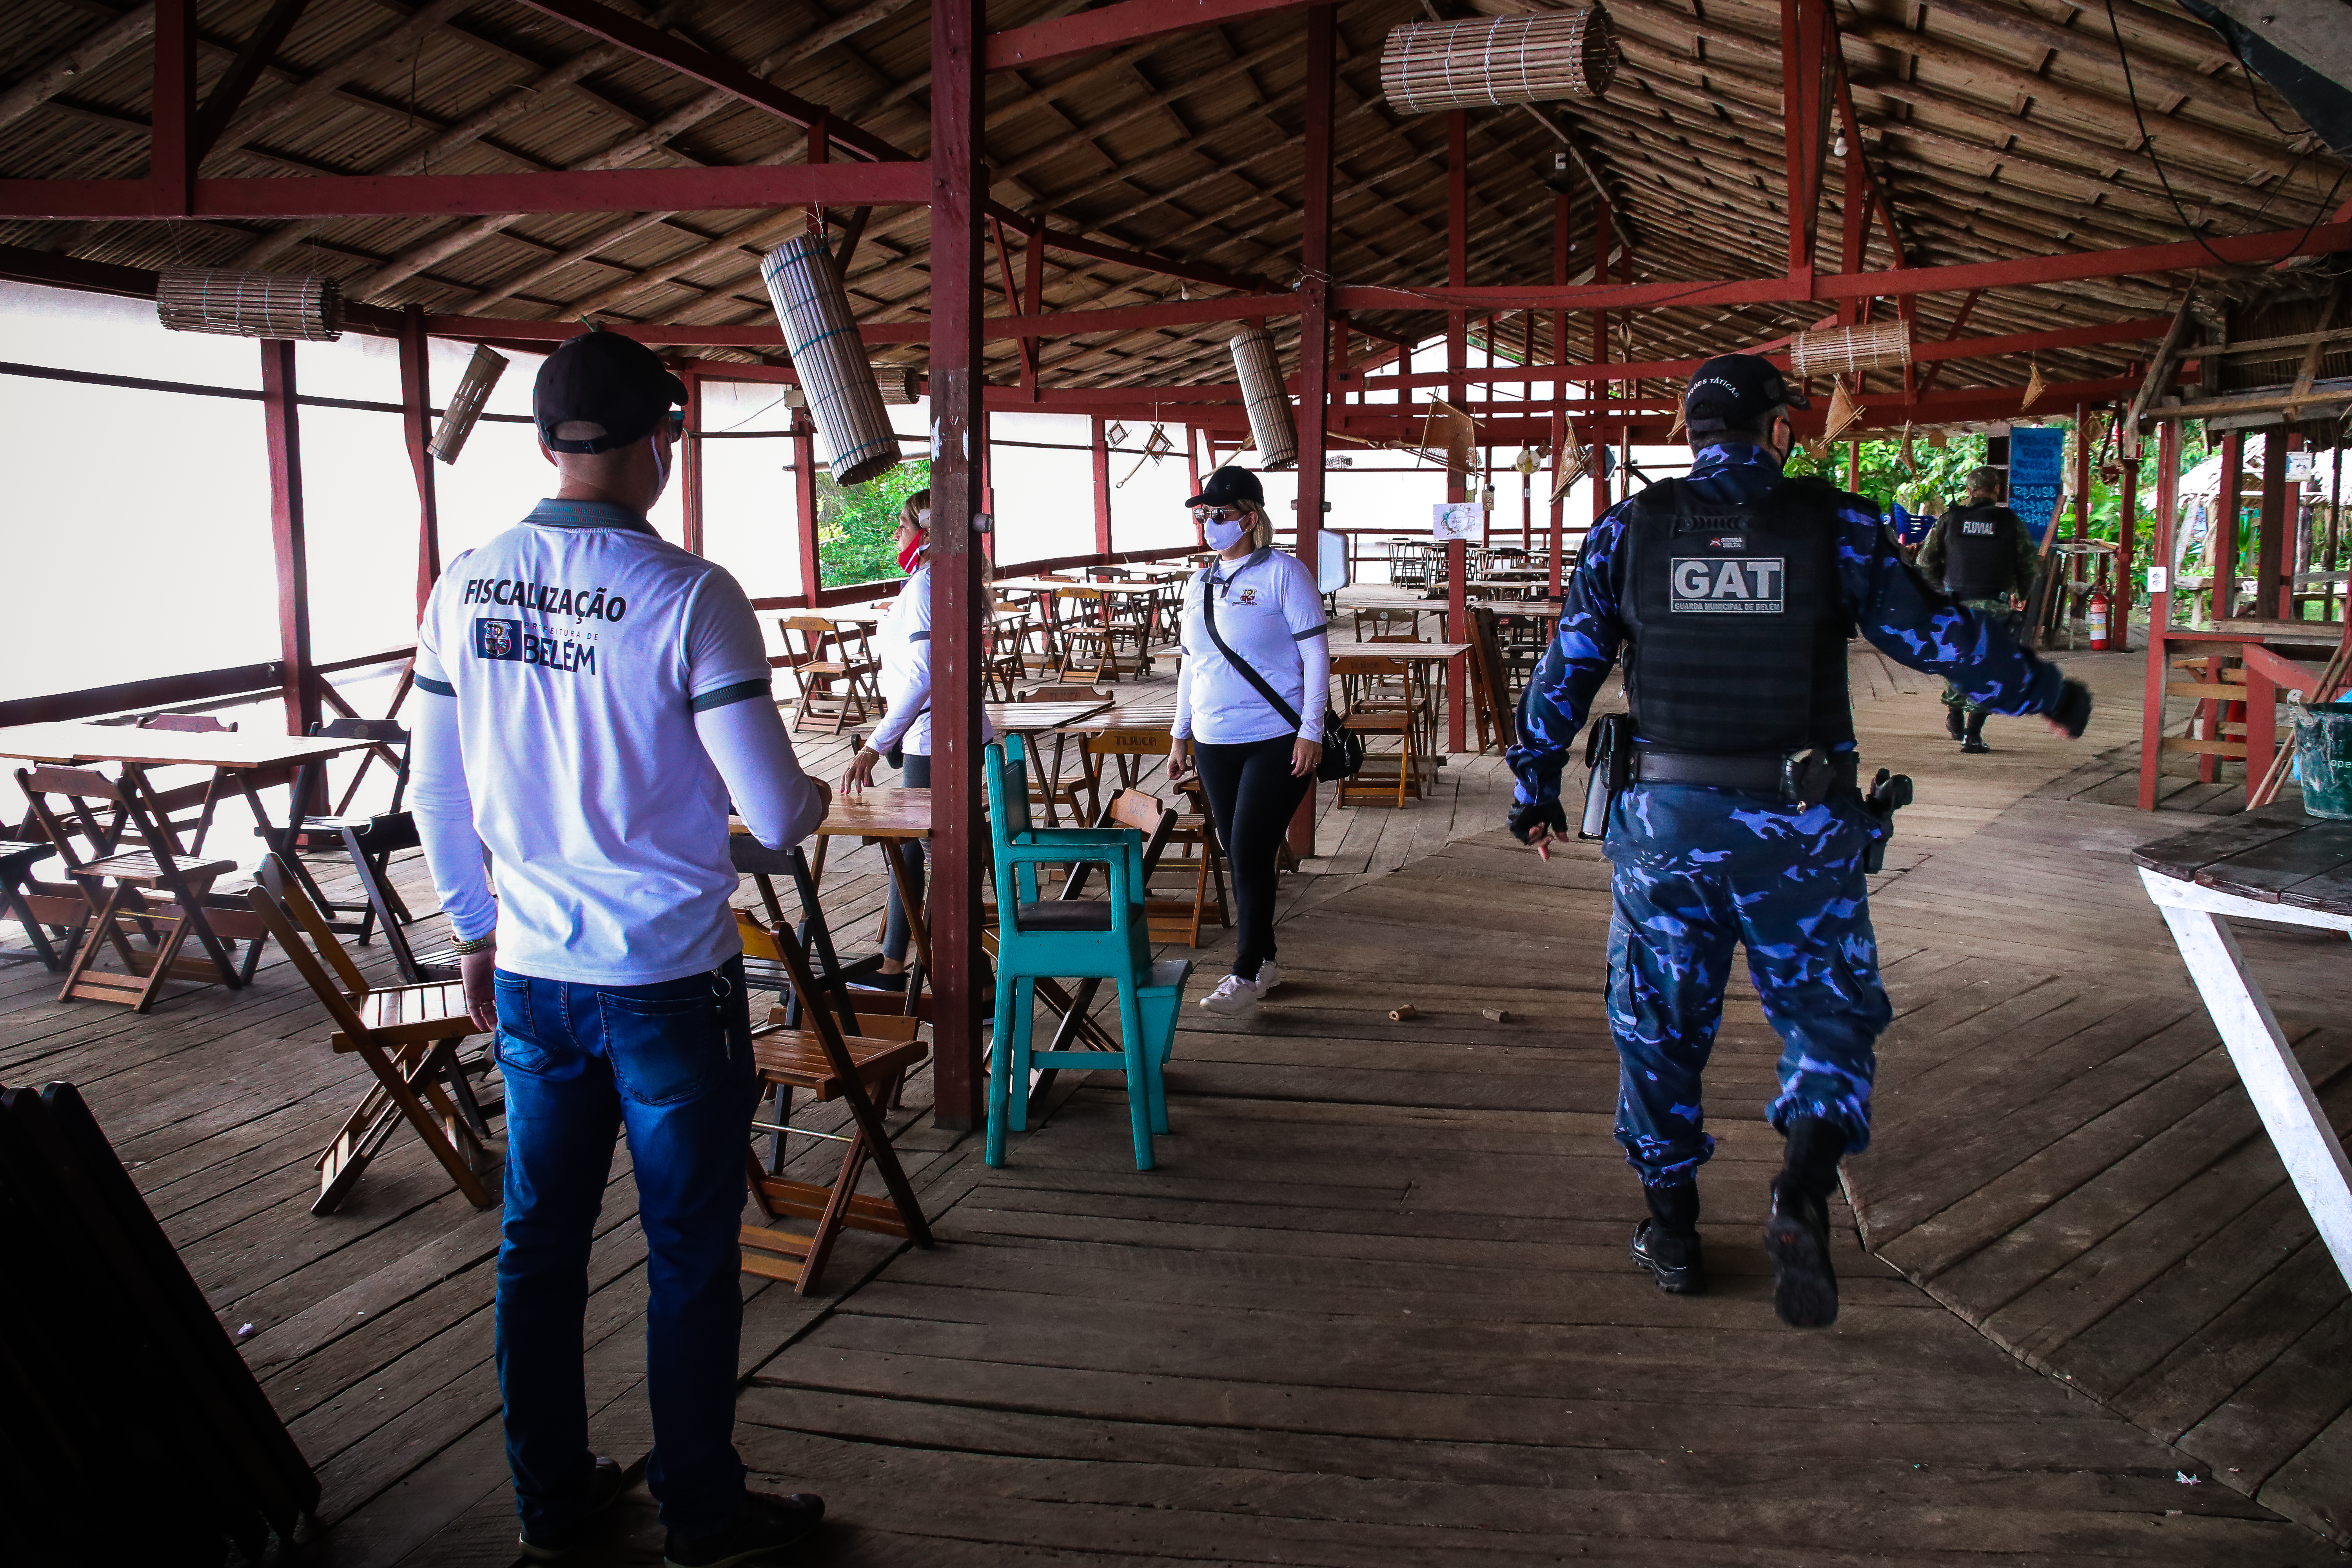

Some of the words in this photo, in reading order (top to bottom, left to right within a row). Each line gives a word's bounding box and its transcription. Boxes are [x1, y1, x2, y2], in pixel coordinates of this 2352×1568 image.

[1709, 376, 1739, 398] TÁTICAS
[1963, 521, 1994, 534] FLUVIAL
[1674, 561, 1780, 598] GAT
[464, 578, 627, 624] FISCALIZAÇÃO
[524, 621, 581, 638] PRFEITURA
[587, 632, 599, 641] DE
[524, 633, 596, 675] BELÉM
[1114, 735, 1157, 746] TIJUCA
